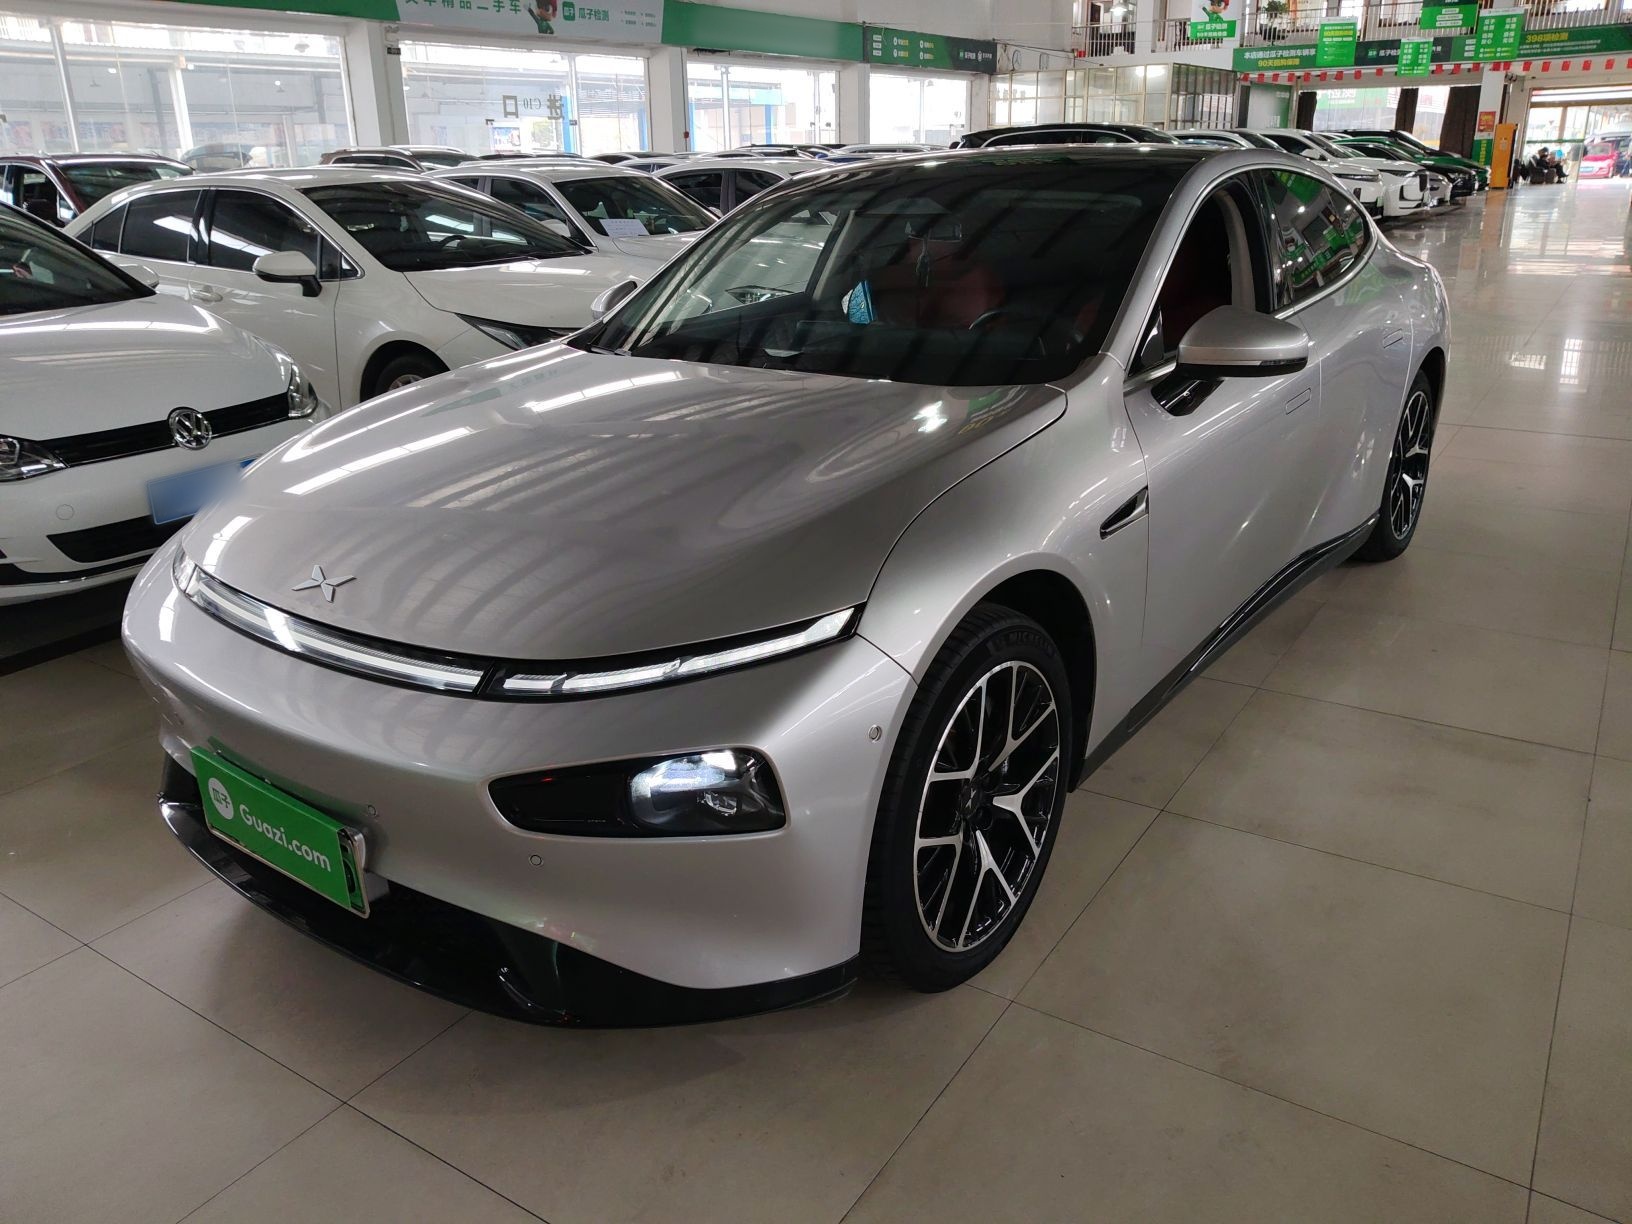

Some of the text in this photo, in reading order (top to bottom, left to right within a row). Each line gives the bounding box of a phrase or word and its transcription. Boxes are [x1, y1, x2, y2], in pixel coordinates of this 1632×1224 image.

[578, 8, 610, 22] 瓜子检测
[239, 804, 332, 873] Guazi.com
